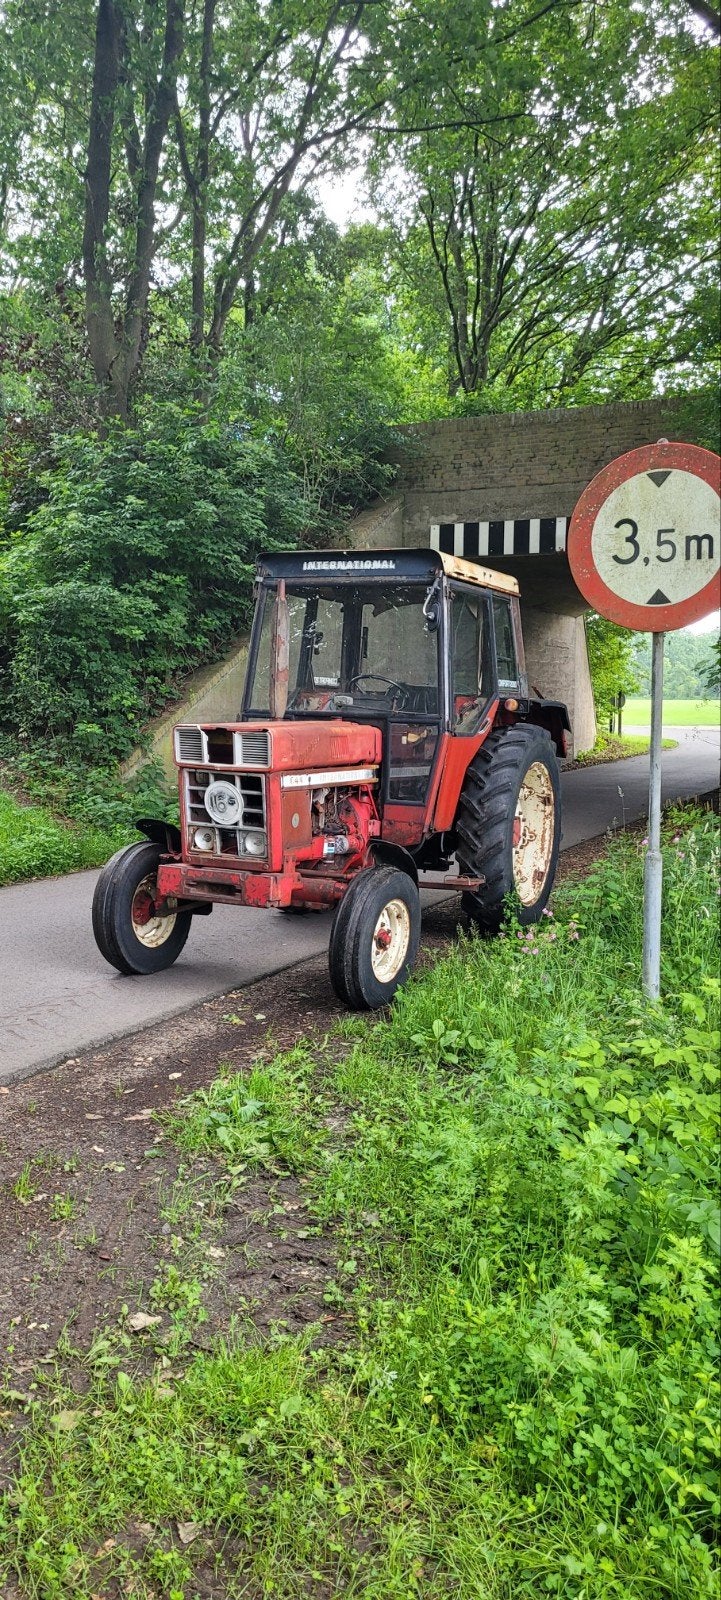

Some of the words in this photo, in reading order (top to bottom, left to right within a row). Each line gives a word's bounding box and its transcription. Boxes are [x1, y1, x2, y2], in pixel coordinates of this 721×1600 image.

[612, 518, 677, 567] 3,5
[685, 533, 714, 561] m
[303, 560, 396, 571] INTERNATIONAL
